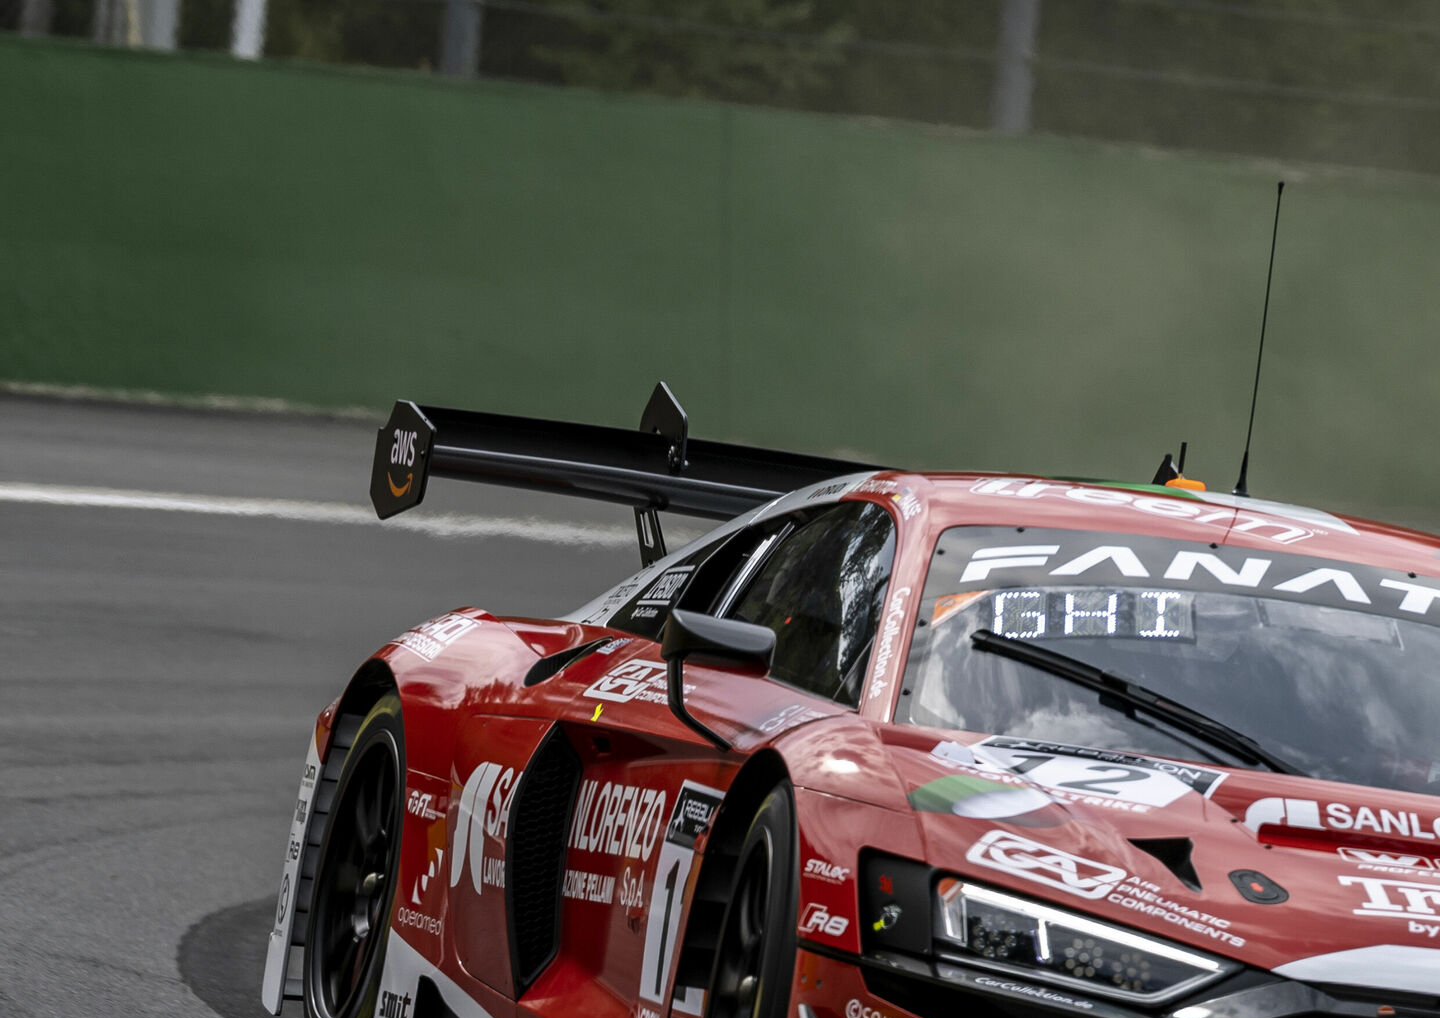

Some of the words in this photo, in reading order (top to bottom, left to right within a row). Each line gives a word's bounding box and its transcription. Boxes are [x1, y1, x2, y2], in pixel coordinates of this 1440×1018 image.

[391, 428, 418, 468] aws
[993, 591, 1181, 639] GHI
[620, 866, 646, 916] SpA
[1126, 875, 1162, 892] AIR
[801, 906, 850, 937] R8
[1107, 893, 1247, 948] COMPONENTS
[1117, 882, 1232, 930] PNEUMATIC
[1408, 920, 1440, 938] by
[975, 976, 1094, 1009] CarCollection.de
